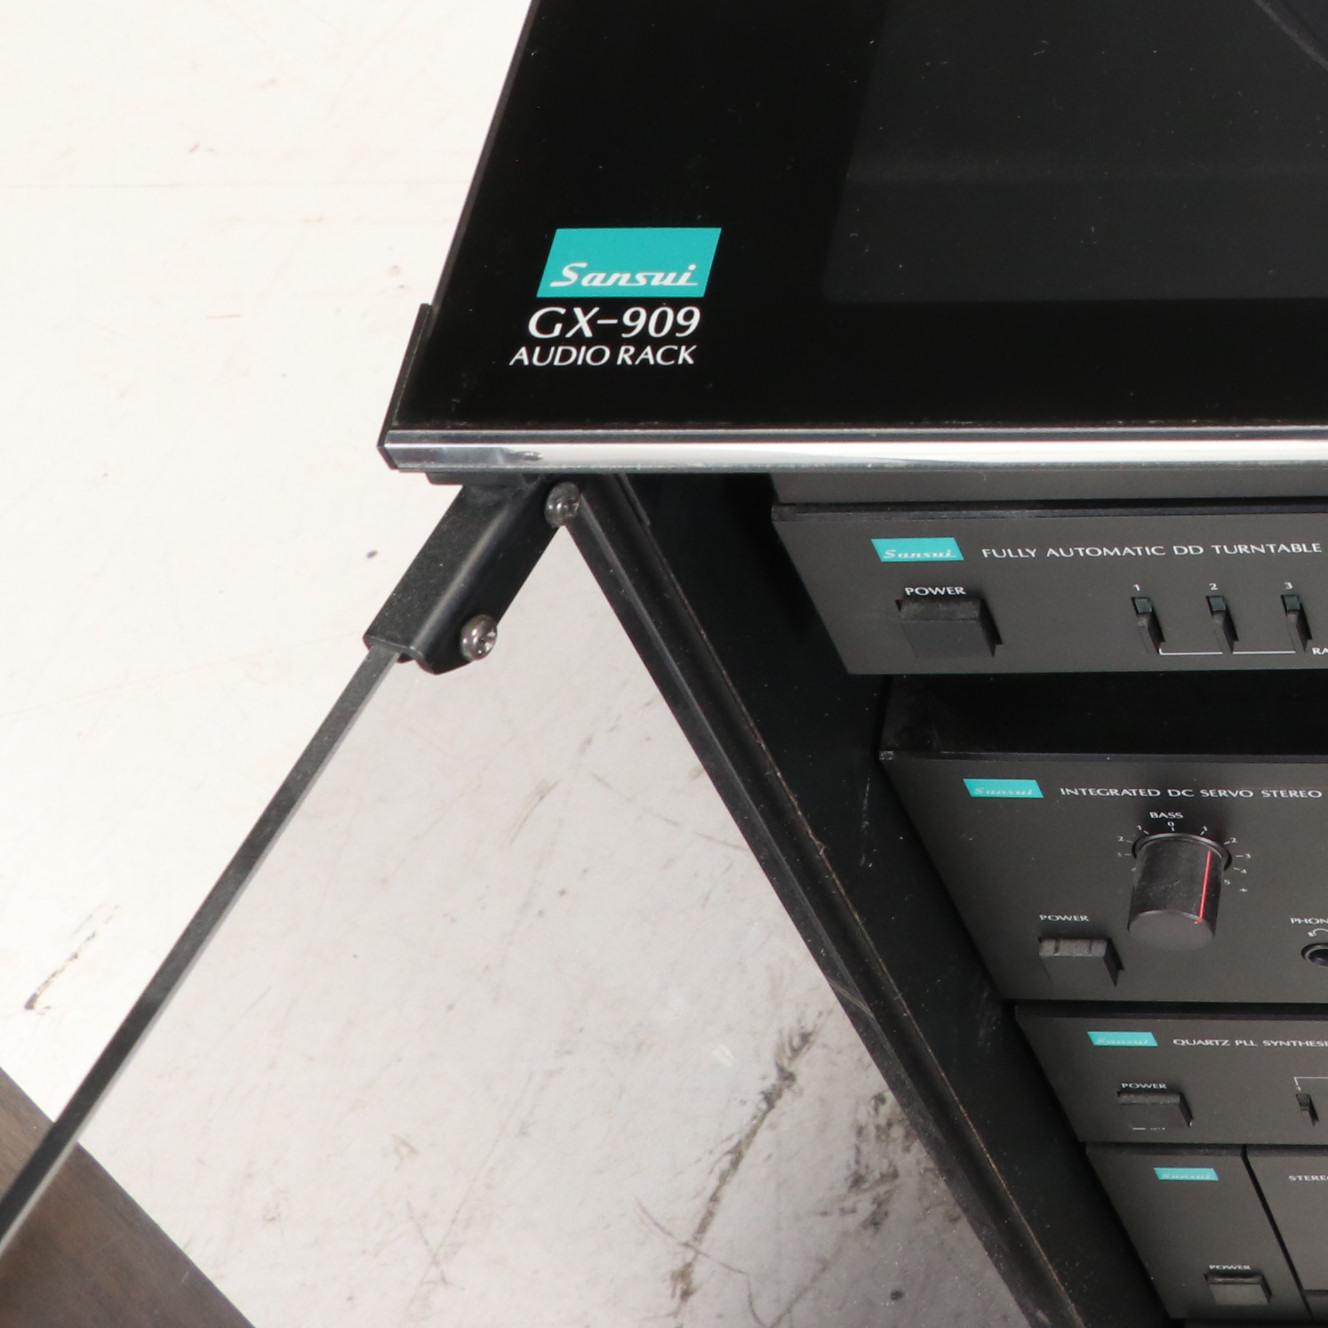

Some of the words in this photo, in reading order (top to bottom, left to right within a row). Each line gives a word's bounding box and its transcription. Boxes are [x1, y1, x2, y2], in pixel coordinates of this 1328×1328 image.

[550, 262, 698, 287] Sansui
[528, 307, 700, 338] GX-909
[509, 345, 610, 366] AUDIO
[616, 345, 697, 365] RACK
[884, 549, 957, 559] Sansui
[982, 548, 1037, 559] FULLY
[1046, 546, 1166, 558] AUTOMATIC
[1173, 545, 1204, 556] DD
[1213, 543, 1322, 555] TURNTABLE
[905, 586, 966, 596] POWER
[1209, 582, 1218, 591] 2
[1285, 582, 1294, 590] 3
[1060, 788, 1161, 798] INTEGRATED
[1167, 788, 1194, 798] DC
[1200, 789, 1254, 798] SERVO
[1261, 790, 1322, 798] STEREO
[1173, 1039, 1230, 1047] QUARTZ
[1235, 1039, 1258, 1047] PLL
